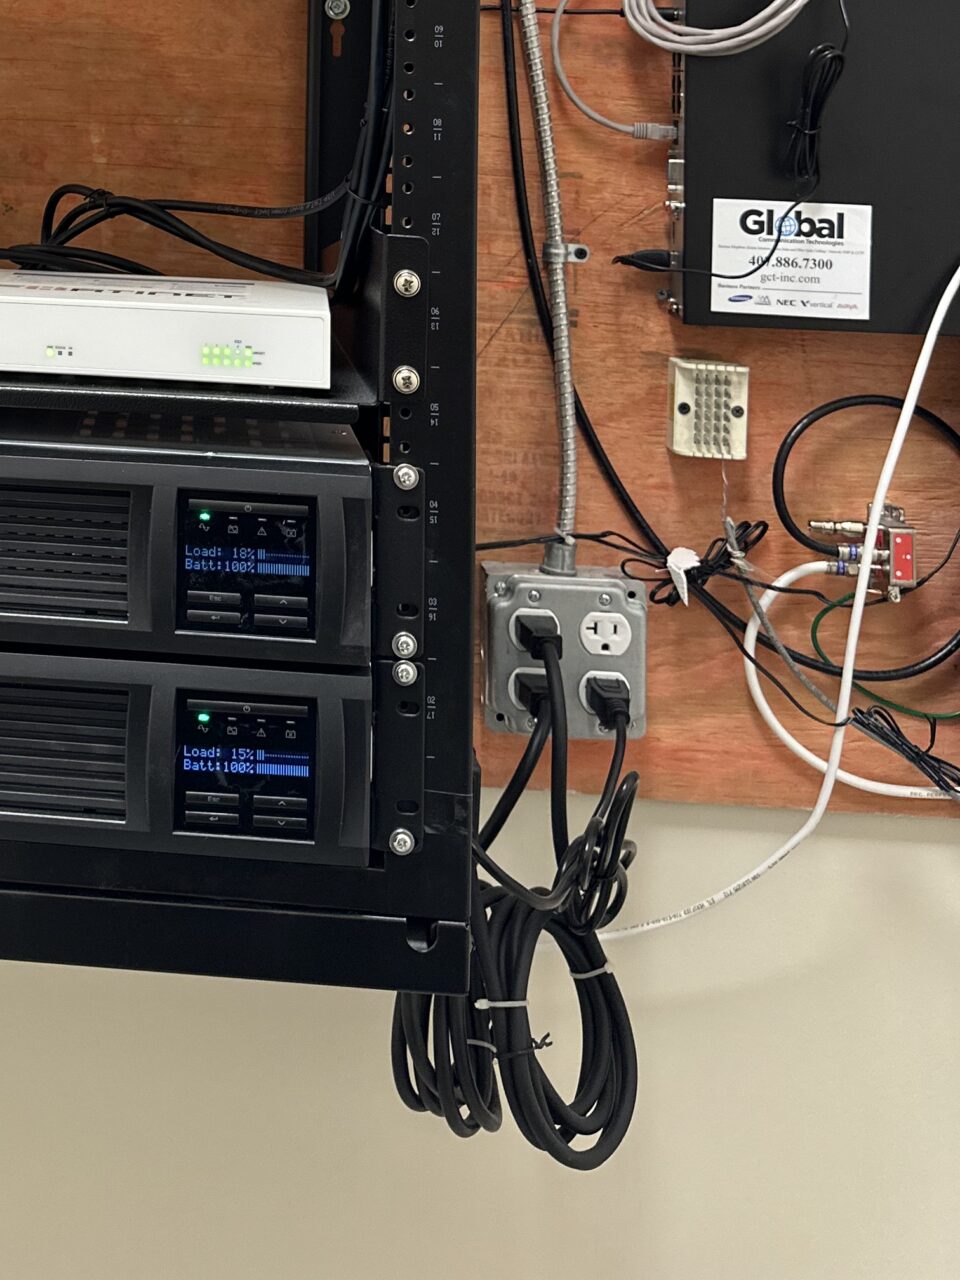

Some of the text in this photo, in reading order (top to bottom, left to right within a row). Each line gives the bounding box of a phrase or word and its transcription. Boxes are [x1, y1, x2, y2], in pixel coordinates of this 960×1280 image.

[805, 238, 844, 247] Technologies
[759, 273, 821, 285] gct-inc.com
[776, 299, 797, 307] NEC
[184, 545, 256, 560] Load: 18%
[183, 745, 255, 760] Load: 15%
